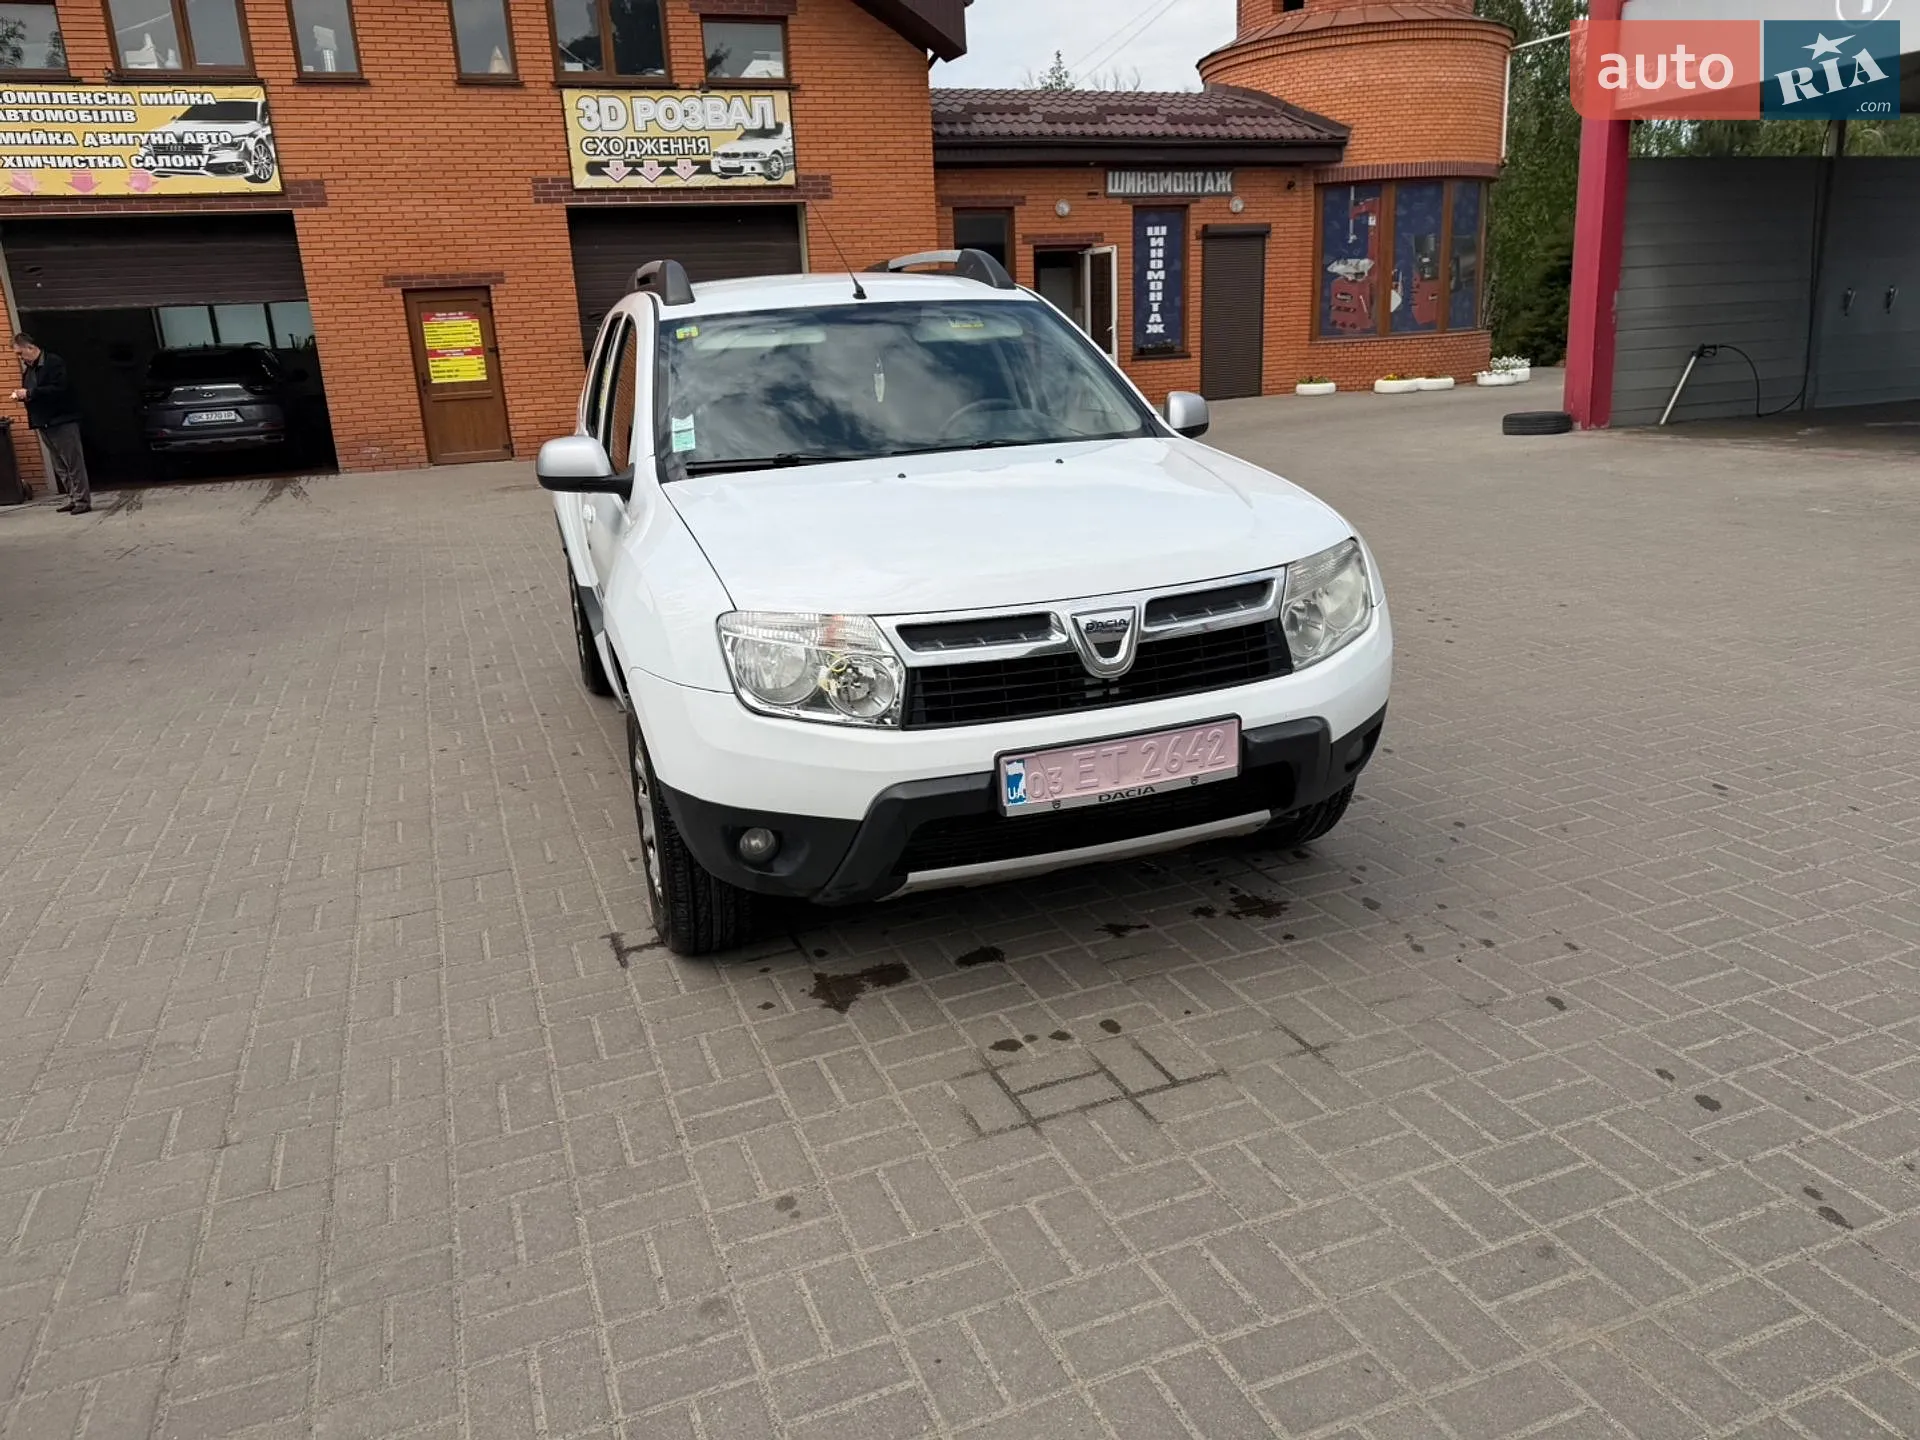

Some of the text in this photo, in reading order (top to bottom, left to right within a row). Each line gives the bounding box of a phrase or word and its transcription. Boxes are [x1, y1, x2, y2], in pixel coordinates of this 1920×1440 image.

[0, 90, 216, 105] ОМПЛЕКСНА МИЙКА
[577, 95, 776, 131] 3D РОЗВАЛ
[0, 129, 77, 145] МИЙКА
[183, 131, 232, 145] АВТО
[580, 136, 711, 158] СХОДЖЕННЯ
[1, 154, 209, 168] ХІМЧИСТКА САЛОНУ
[1107, 171, 1233, 193] ШИНОМОНТАЖ
[1146, 226, 1167, 334] ШИНОМОНТАЖ
[1008, 728, 1226, 799] UA 03 ET 2642
[1098, 785, 1157, 803] DACIA
